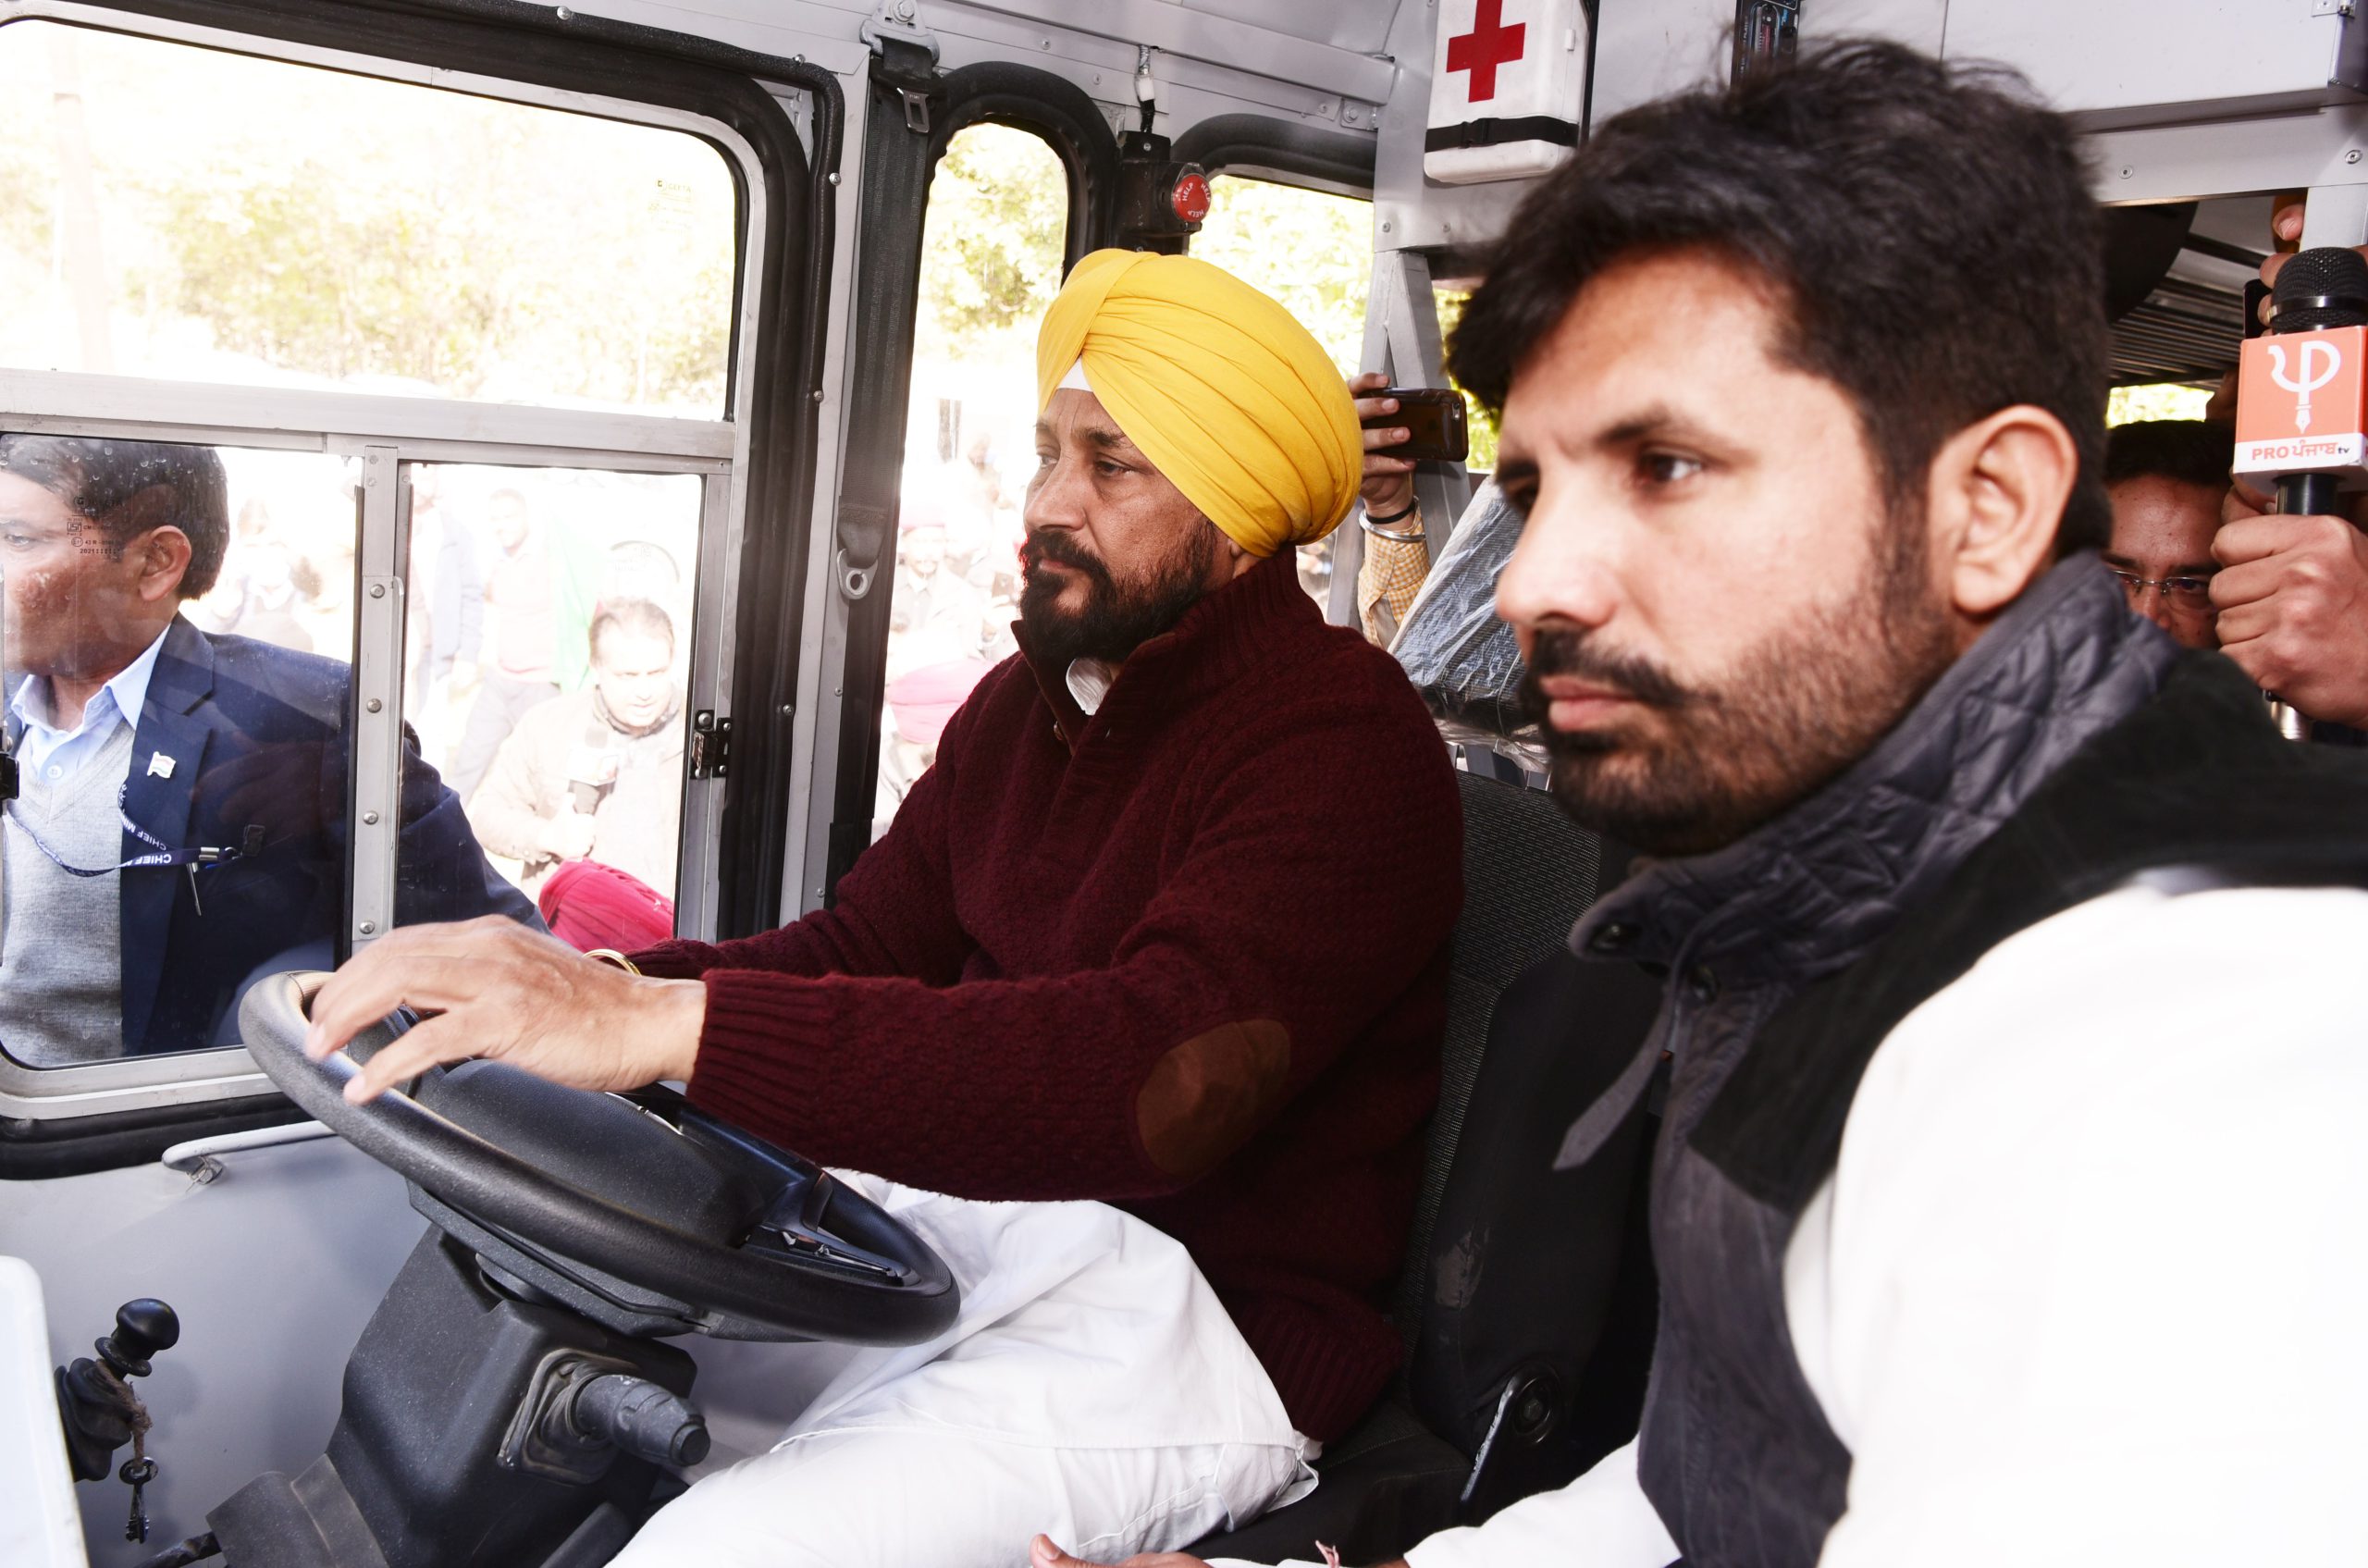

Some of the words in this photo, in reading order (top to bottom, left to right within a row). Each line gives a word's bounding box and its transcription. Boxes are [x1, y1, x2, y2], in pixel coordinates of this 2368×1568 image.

[1182, 182, 1193, 202] HELP
[1201, 183, 1211, 203] HELP
[1187, 209, 1204, 218] HELP
[2251, 446, 2289, 461] PRO
[2291, 438, 2338, 458] ਪੰਜਾਬ
[137, 830, 166, 851] CHIEF
[135, 853, 172, 864] CHIEF
